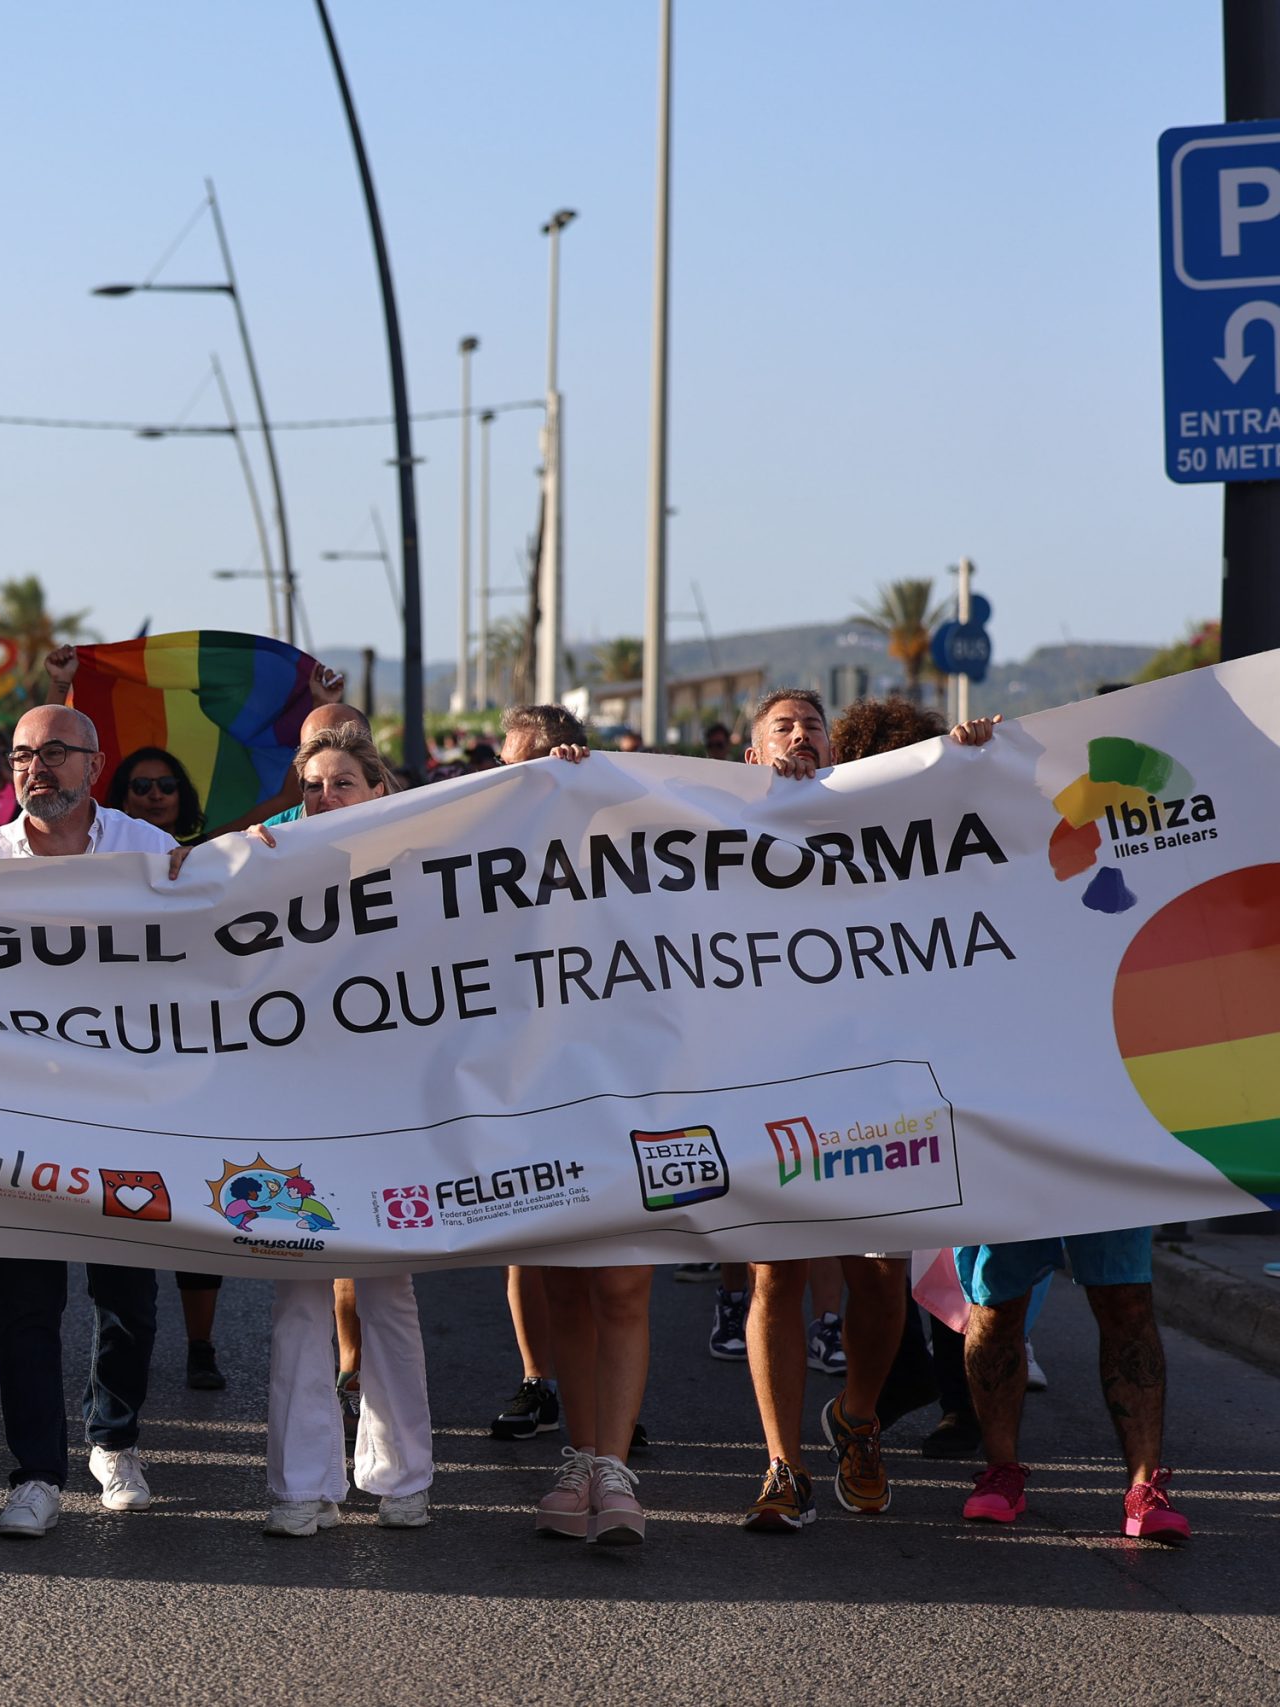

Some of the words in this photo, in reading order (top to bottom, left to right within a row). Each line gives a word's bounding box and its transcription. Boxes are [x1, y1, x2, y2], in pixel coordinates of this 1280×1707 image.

[1218, 166, 1280, 257] P
[1180, 406, 1280, 438] ENTRA
[1177, 446, 1207, 473] 50
[1216, 443, 1280, 471] MET
[1105, 794, 1216, 841] Ibiza
[1114, 841, 1150, 859] Illes
[1154, 826, 1218, 851] Balears
[215, 868, 399, 957] QUE
[422, 812, 1009, 919] TRANSFORMA
[332, 958, 498, 1034] QUE
[514, 911, 1017, 1008] TRANSFORMA
[819, 1130, 841, 1146] sa
[847, 1121, 888, 1142] clau
[894, 1112, 918, 1135] de
[643, 1143, 713, 1159] IBIZA
[435, 1160, 585, 1210] FELGTBI+
[647, 1160, 719, 1190] LGTB
[440, 1204, 483, 1219] Federación
[485, 1201, 512, 1213] Estatal
[513, 1198, 524, 1207] de
[525, 1191, 567, 1205] Lesbianas,
[441, 1217, 465, 1227] Trans,
[467, 1208, 511, 1225] Bisexuales,
[512, 1200, 564, 1215] Intersexuales
[233, 1235, 325, 1251] Chrysallis
